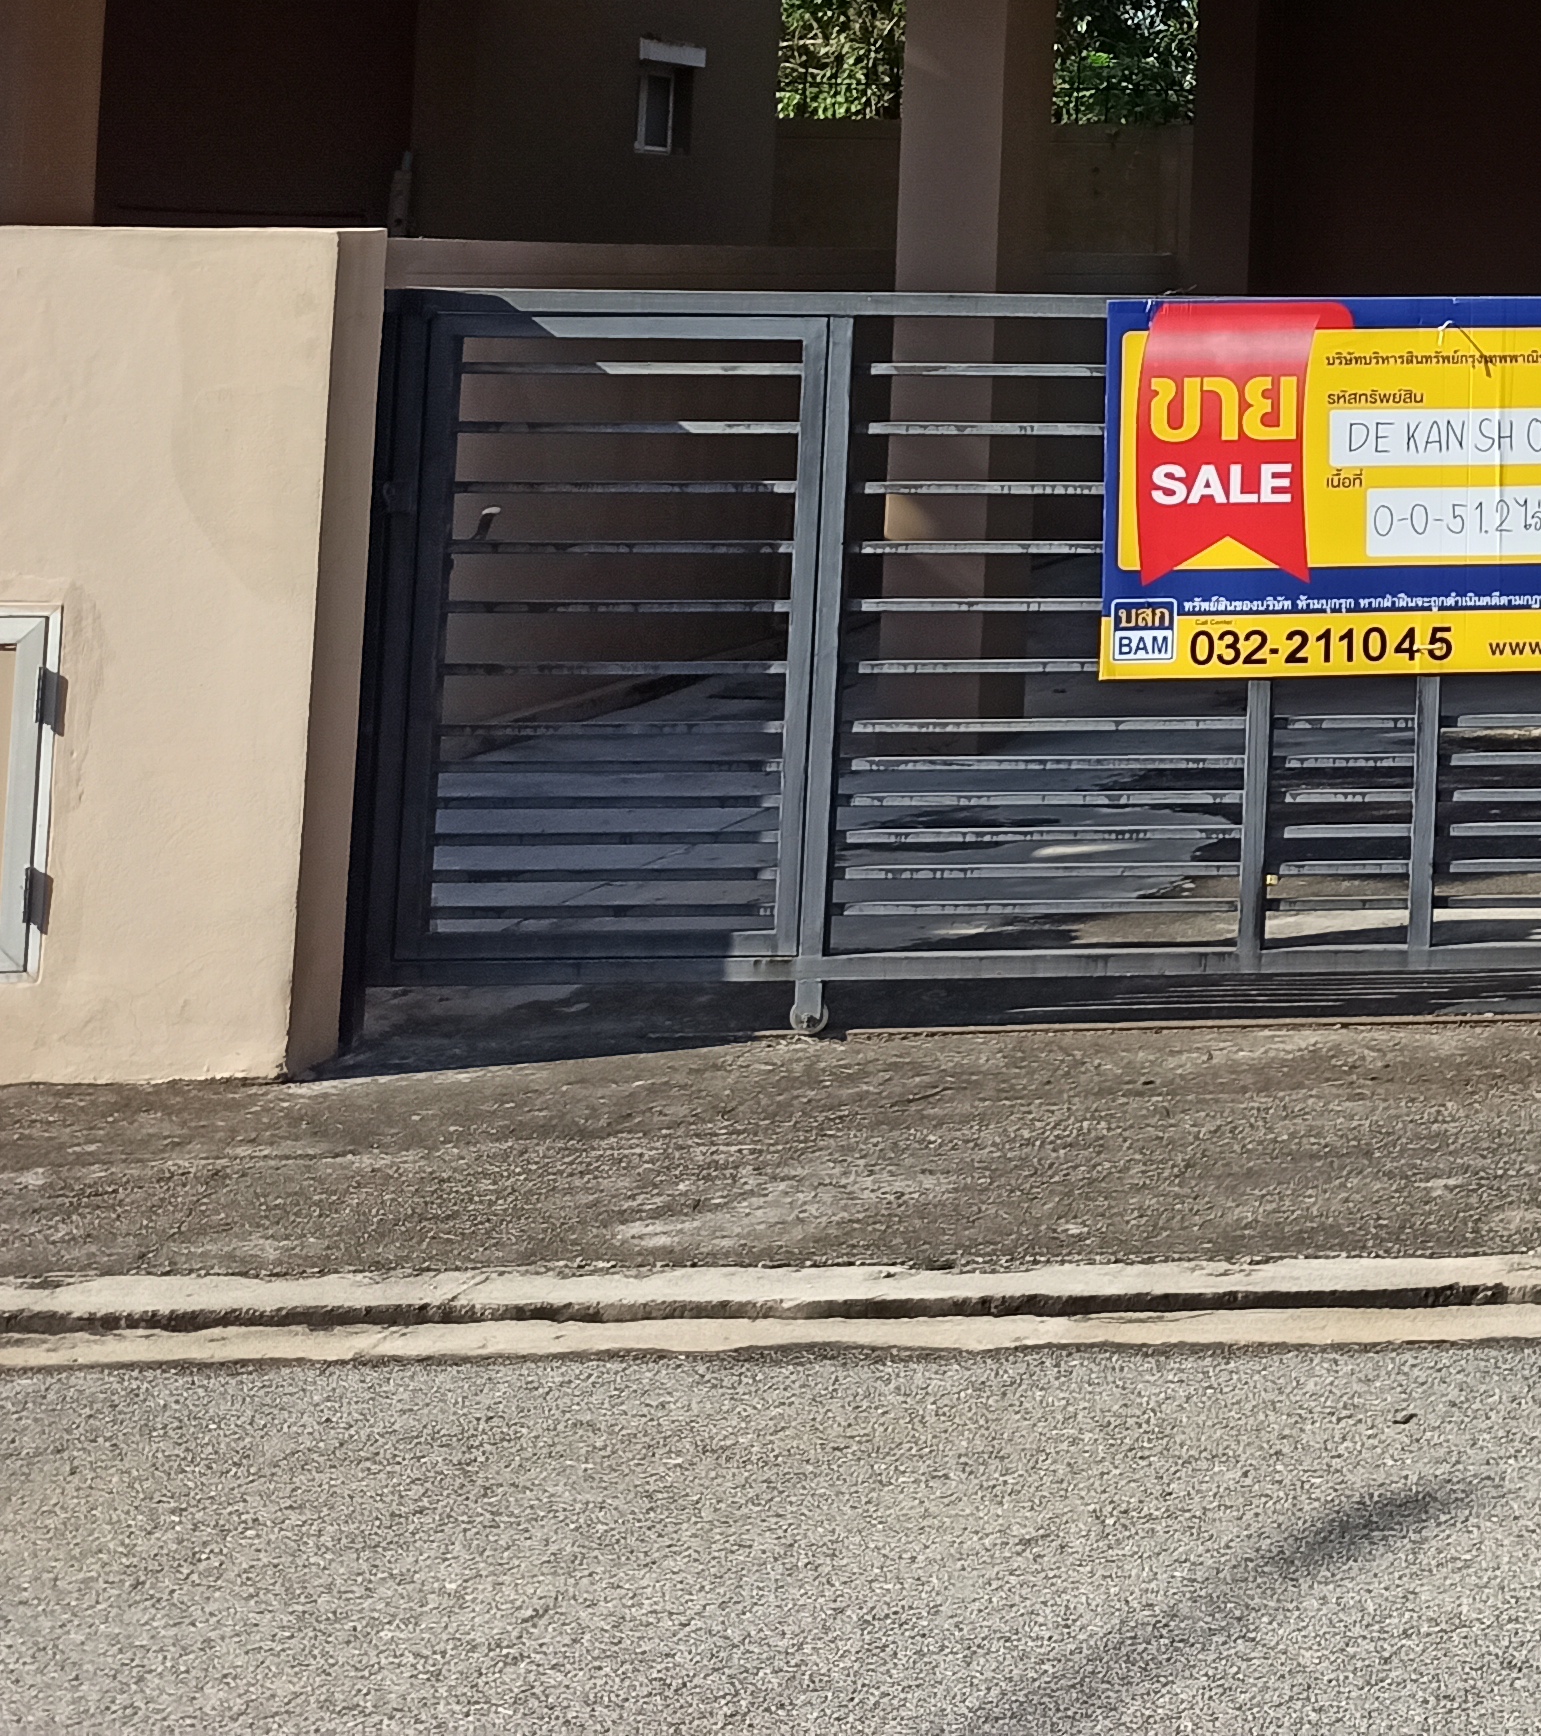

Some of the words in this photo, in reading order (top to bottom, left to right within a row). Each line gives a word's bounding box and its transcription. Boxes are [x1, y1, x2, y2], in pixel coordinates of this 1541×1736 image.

[1150, 376, 1298, 442] ขาย
[1327, 388, 1424, 405] รหัสทรัพย์สิน
[1349, 421, 1395, 453] DE
[1405, 419, 1466, 454] KAN
[1150, 463, 1292, 505] SALE
[1326, 467, 1363, 489] เนื้อที่
[1118, 607, 1170, 628] บสก
[1118, 635, 1169, 655] BAM
[1189, 626, 1453, 665] 032-211045
